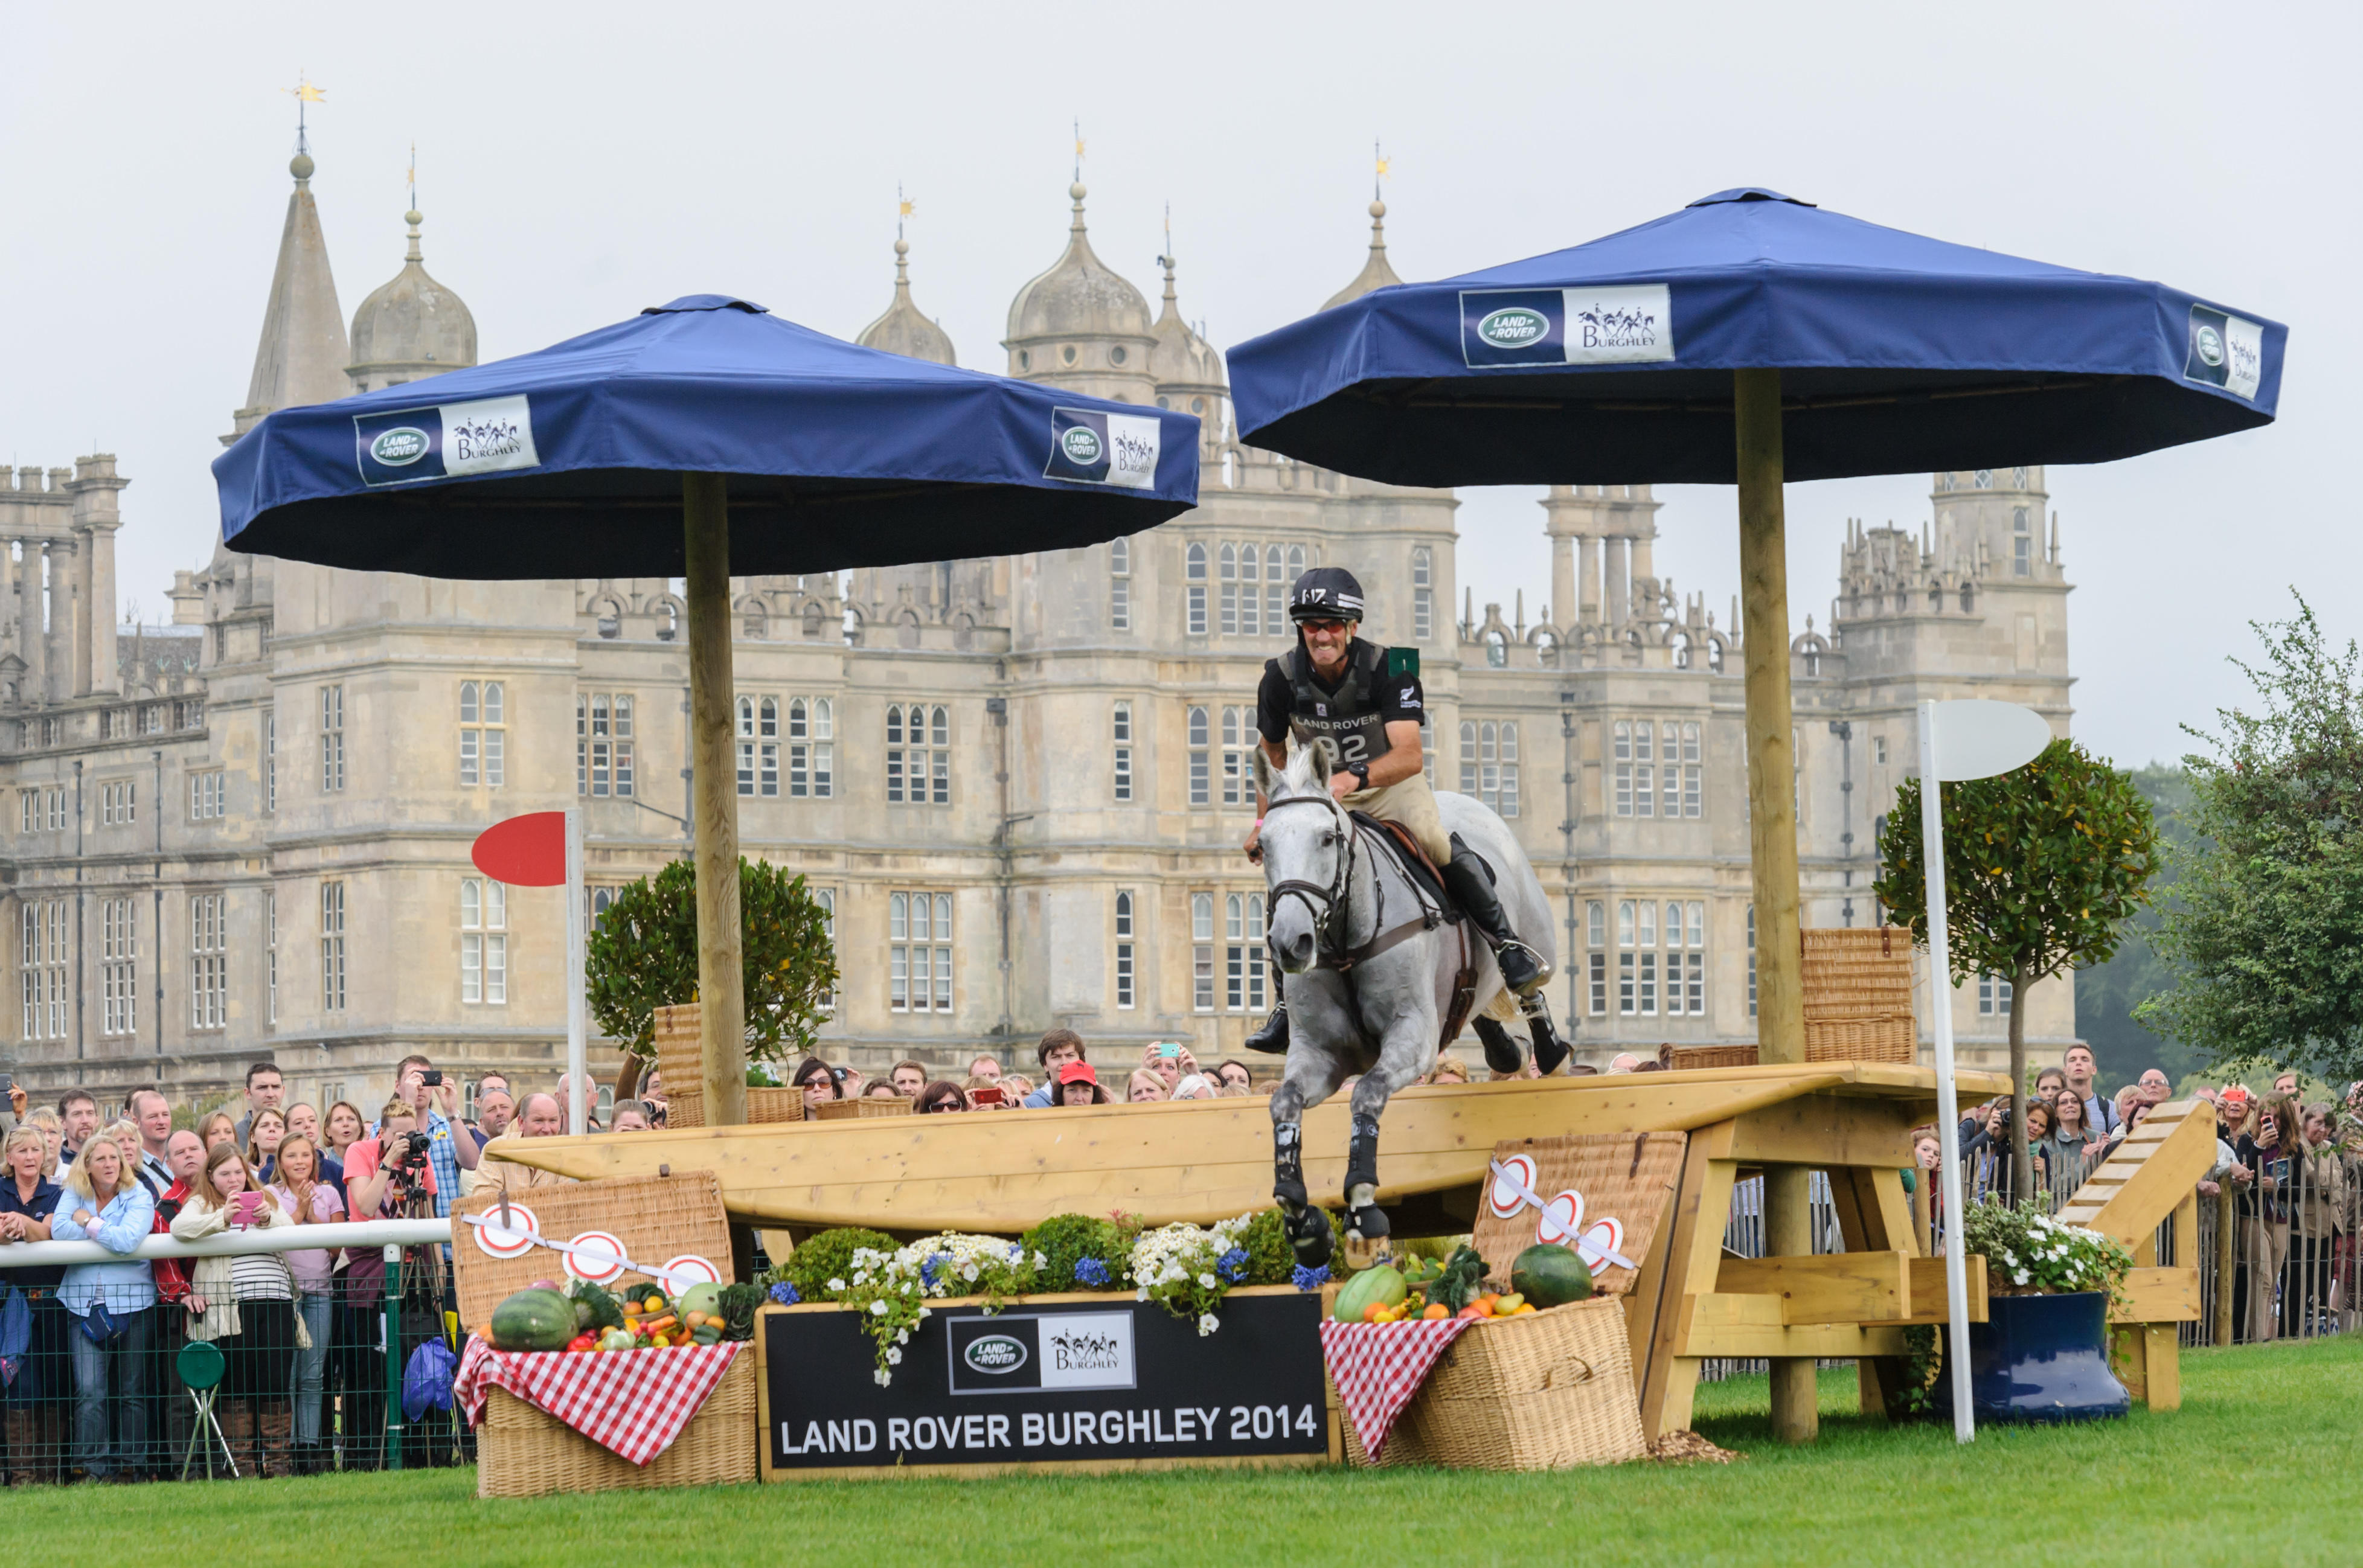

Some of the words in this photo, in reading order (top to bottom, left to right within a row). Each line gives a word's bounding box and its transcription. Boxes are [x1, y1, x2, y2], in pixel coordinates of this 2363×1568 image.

[1493, 316, 1527, 327] LAND
[1495, 326, 1536, 338] ROVER
[383, 435, 411, 446] LAND
[1070, 434, 1089, 444] LAND
[385, 444, 418, 458] ROVER
[1072, 444, 1095, 455] ROVER
[1295, 716, 1330, 730] LAND
[1332, 714, 1378, 730] ROVER
[1314, 734, 1369, 763] 92
[977, 1343, 1007, 1354] LAND
[980, 1353, 1016, 1365] ROVER
[781, 1418, 877, 1454] LAND
[888, 1414, 1012, 1451] ROVER
[1022, 1407, 1221, 1447] BURGHLEY
[1230, 1404, 1317, 1440] 2014
